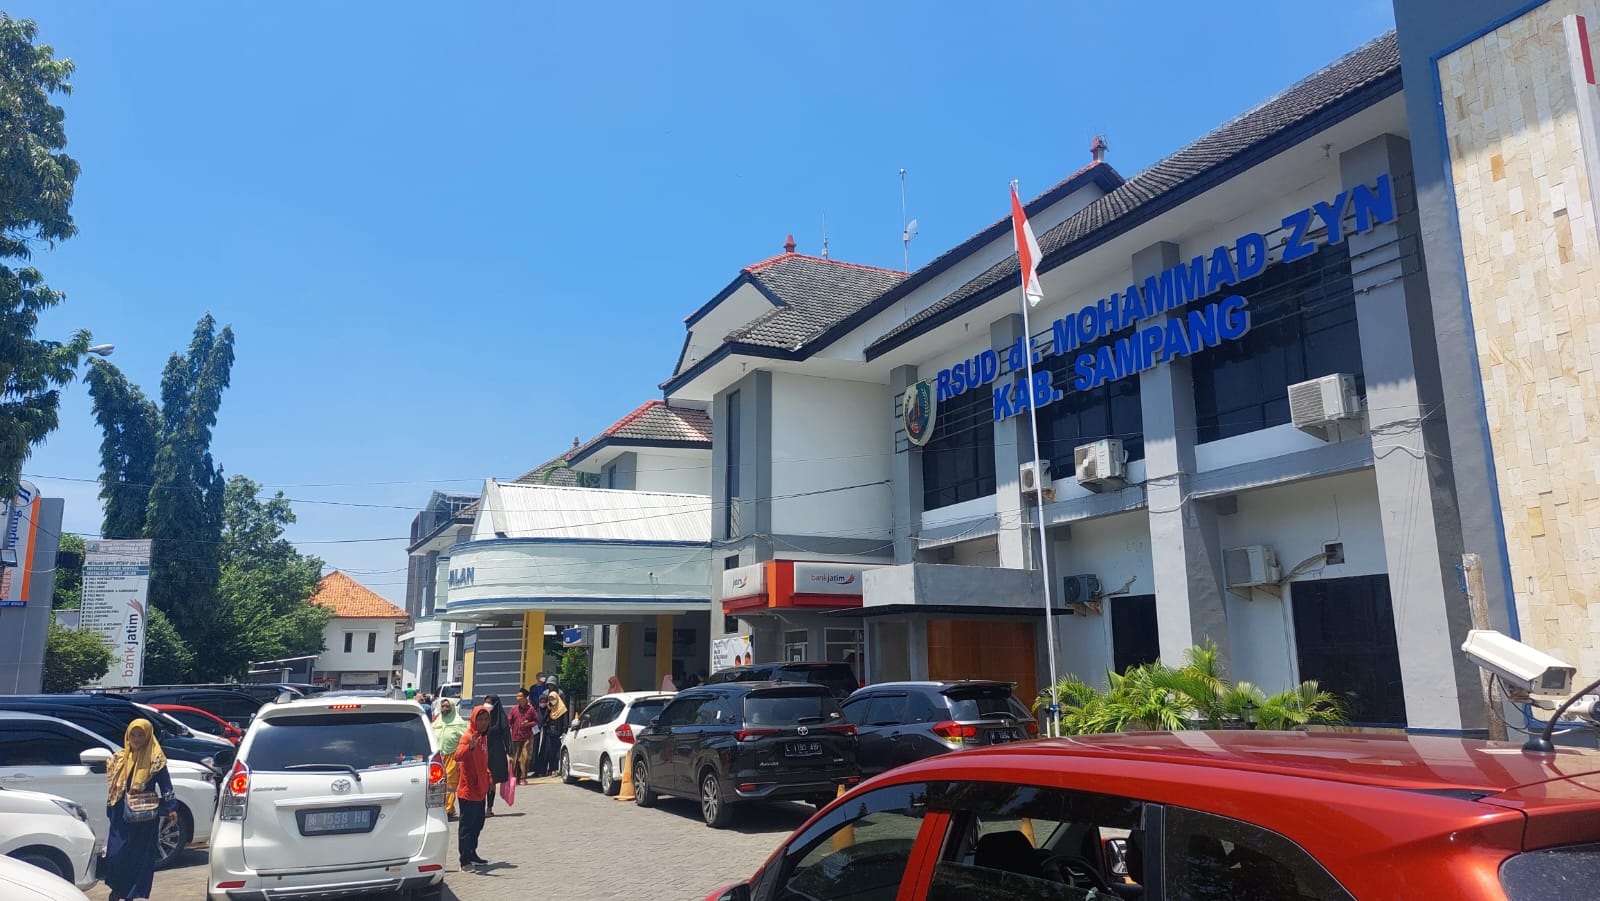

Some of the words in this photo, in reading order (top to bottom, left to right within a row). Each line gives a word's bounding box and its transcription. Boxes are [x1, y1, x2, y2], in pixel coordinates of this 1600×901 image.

[937, 350, 998, 401] RSUD
[1009, 336, 1042, 371] dr.
[1053, 232, 1268, 356] MOHAMMAD
[1281, 173, 1396, 264] ZYN
[994, 370, 1063, 421] KAB.
[1074, 295, 1250, 391] SAMPANG
